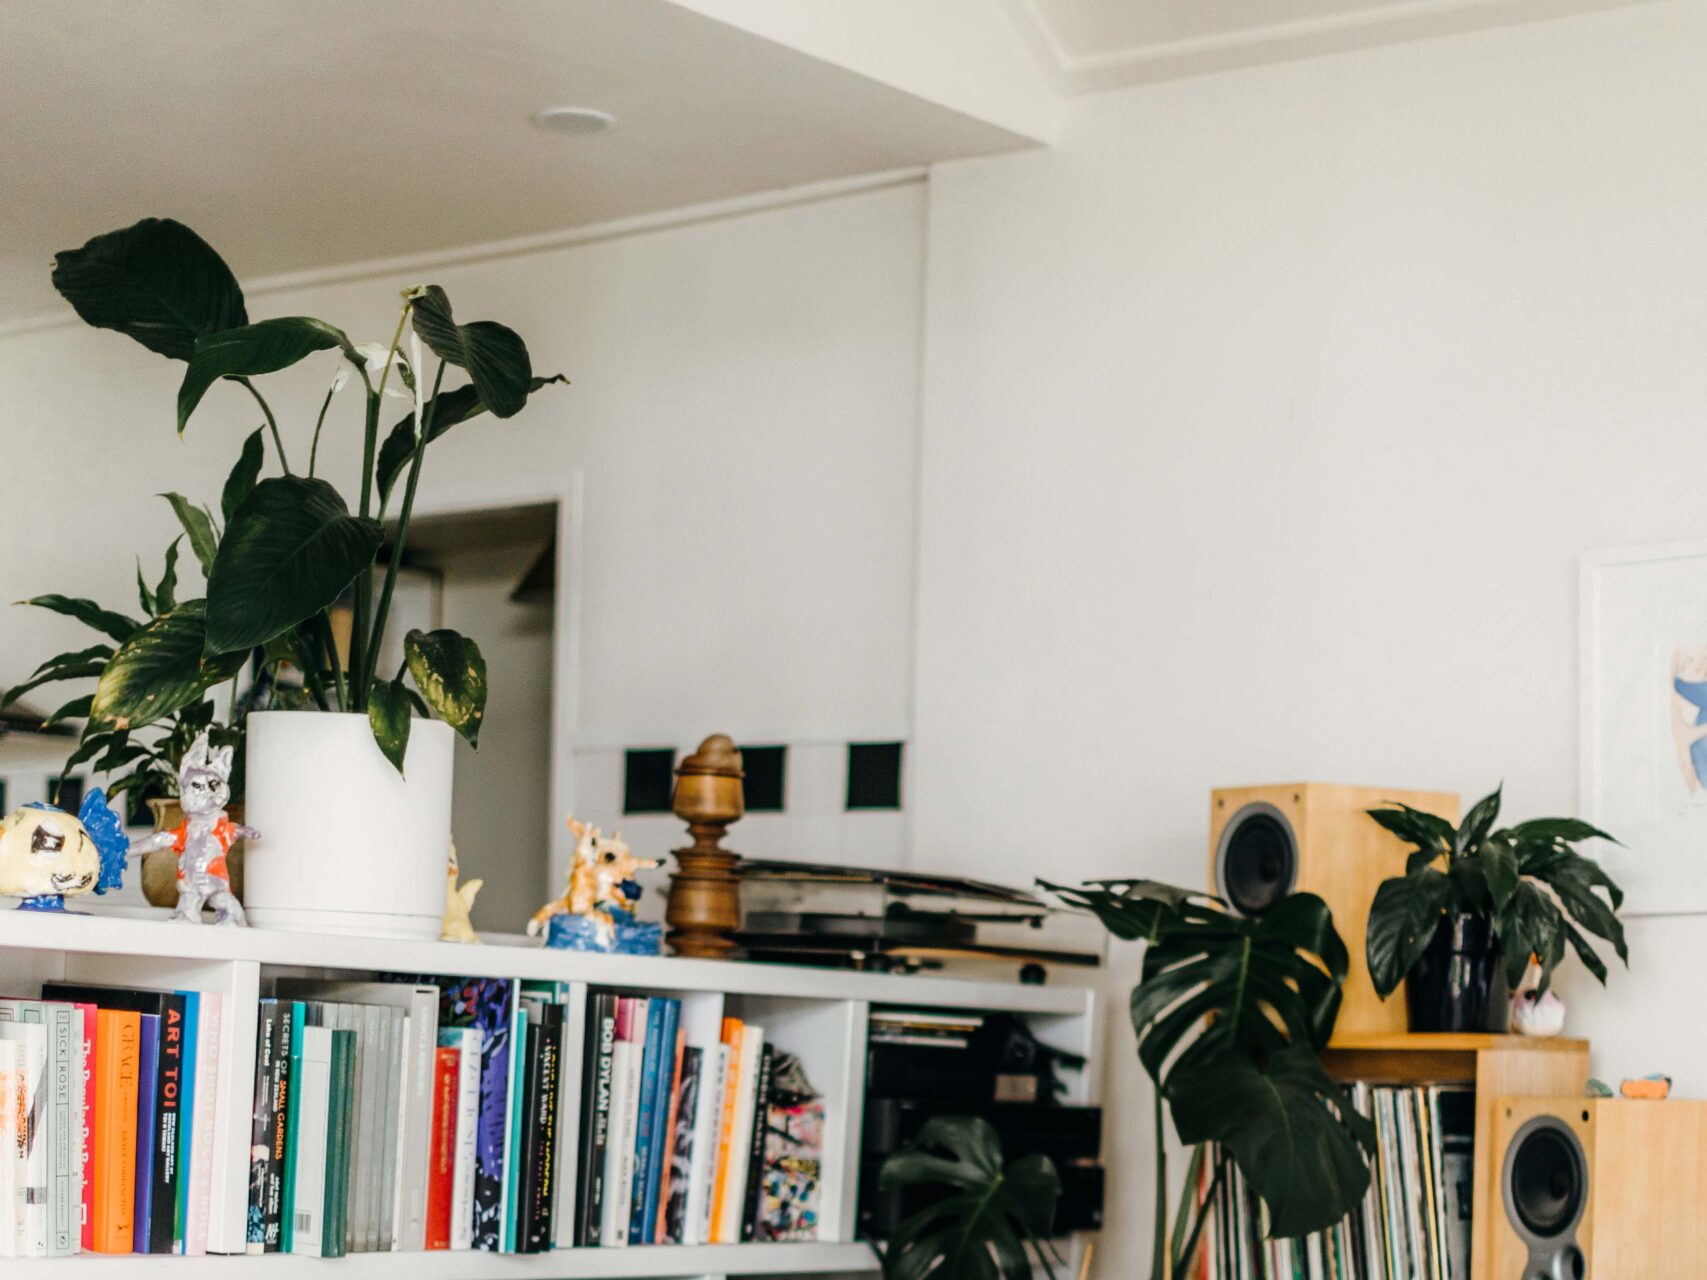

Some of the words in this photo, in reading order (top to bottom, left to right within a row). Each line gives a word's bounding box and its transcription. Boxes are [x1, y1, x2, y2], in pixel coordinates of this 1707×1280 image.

[58, 1027, 67, 1056] SICK
[119, 1024, 136, 1088] GRACE
[165, 1008, 182, 1059] ART
[281, 1013, 291, 1057] SECRETS
[601, 1017, 615, 1054] BOB
[58, 1066, 67, 1100] ROSE
[163, 1066, 179, 1108] TOI
[280, 1060, 288, 1075] OF
[542, 1045, 552, 1090] VINCENT
[599, 1057, 612, 1111] DYLAN
[758, 1054, 771, 1105] DEBBIE
[278, 1080, 287, 1110] SMALL
[540, 1094, 549, 1124] WARD
[201, 1121, 215, 1169] ROCK
[275, 1112, 286, 1160] GARDENS
[753, 1110, 765, 1157] HARRY
[198, 1196, 210, 1241] ROLL
